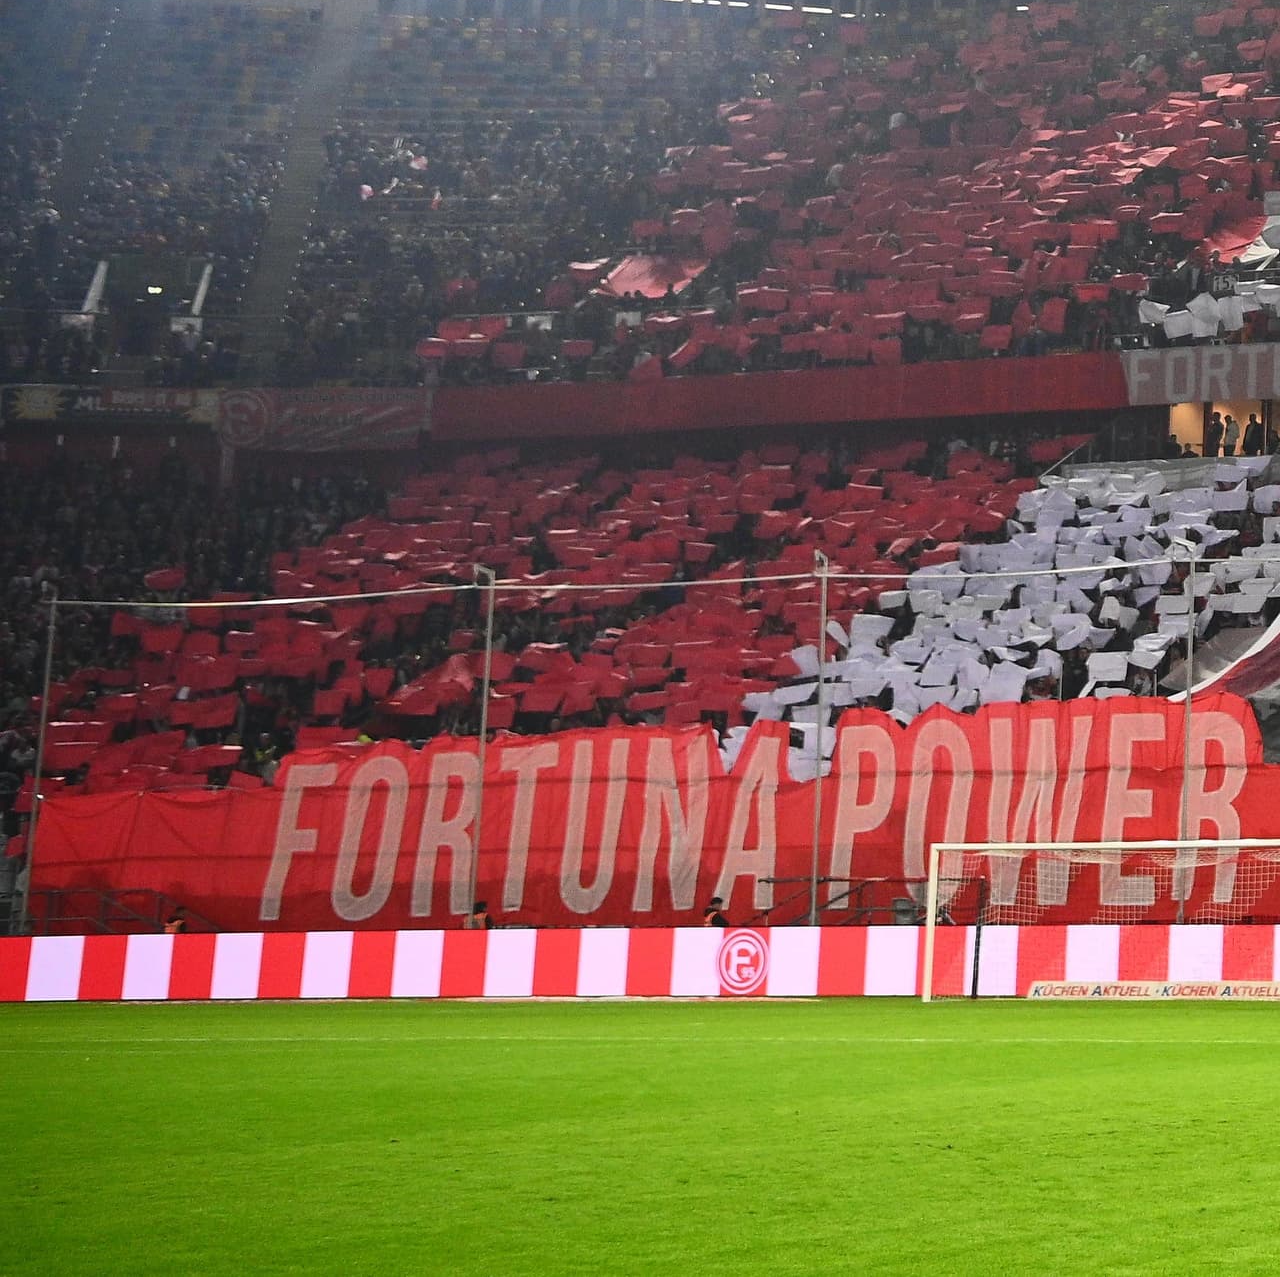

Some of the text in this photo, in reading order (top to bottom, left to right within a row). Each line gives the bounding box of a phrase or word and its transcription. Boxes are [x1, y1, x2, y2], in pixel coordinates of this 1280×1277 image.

[259, 736, 780, 921] FORTUNA
[828, 711, 1248, 910] POWER
[1032, 983, 1089, 997] KÜCHEN
[1091, 985, 1152, 997] AKTUELL
[1161, 983, 1218, 997] KÜCHEN
[1220, 985, 1280, 997] AKTUELL
